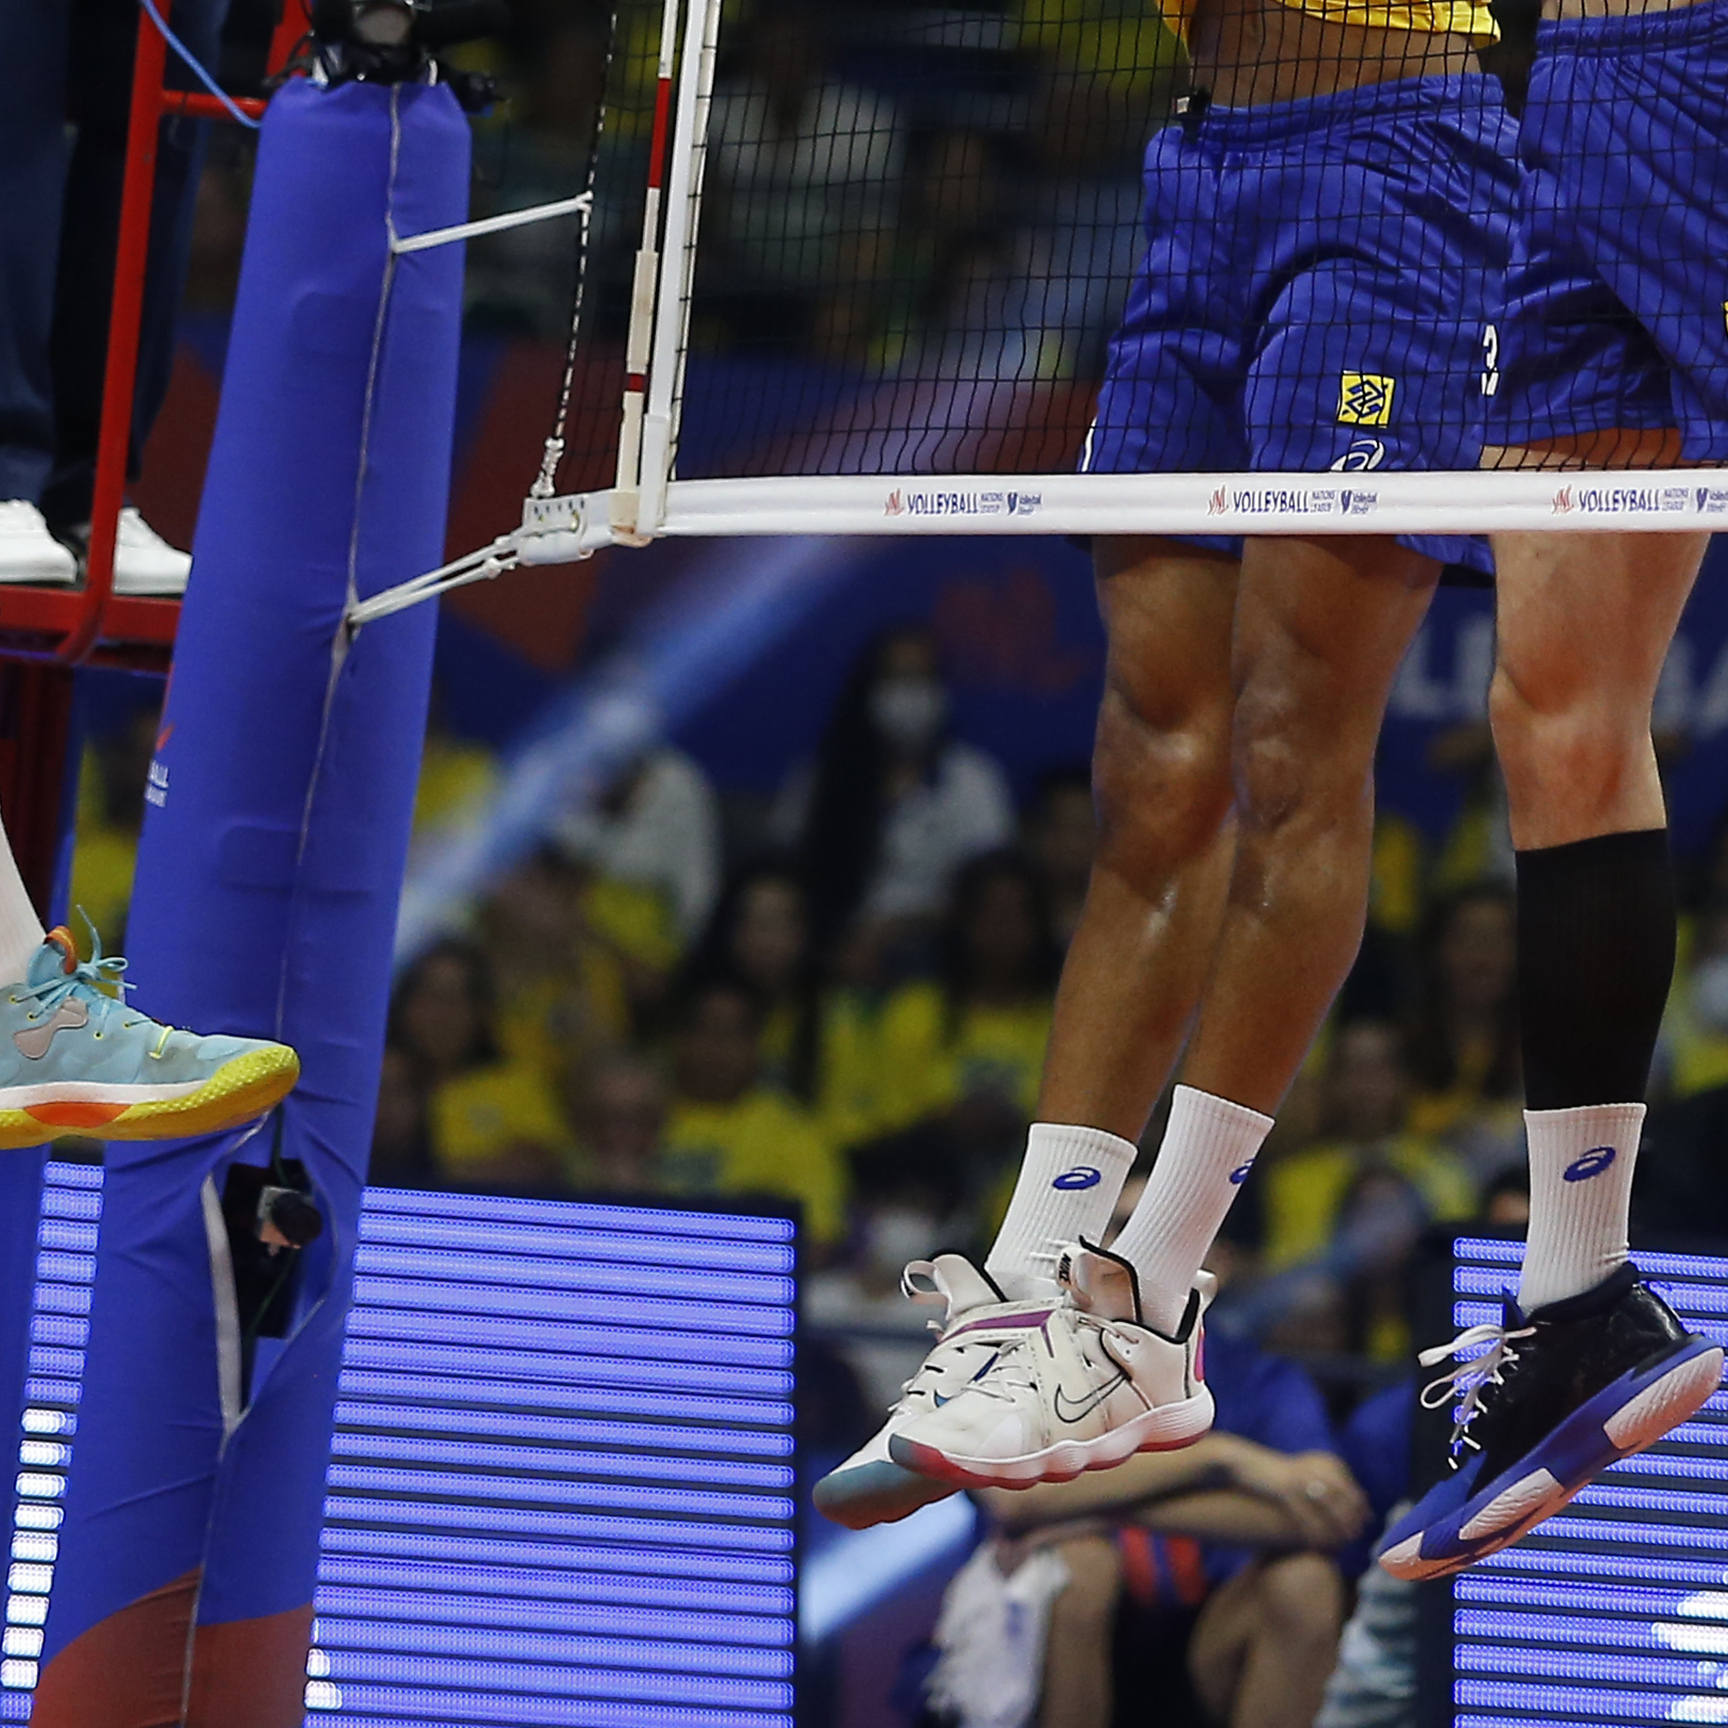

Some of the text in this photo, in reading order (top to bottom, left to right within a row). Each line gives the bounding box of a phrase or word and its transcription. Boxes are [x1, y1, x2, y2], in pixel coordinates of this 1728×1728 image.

[907, 492, 979, 515] VOLLEYBALL
[1232, 490, 1309, 513] VOLLEYBALL
[1579, 489, 1660, 512] VOLLEYBALL
